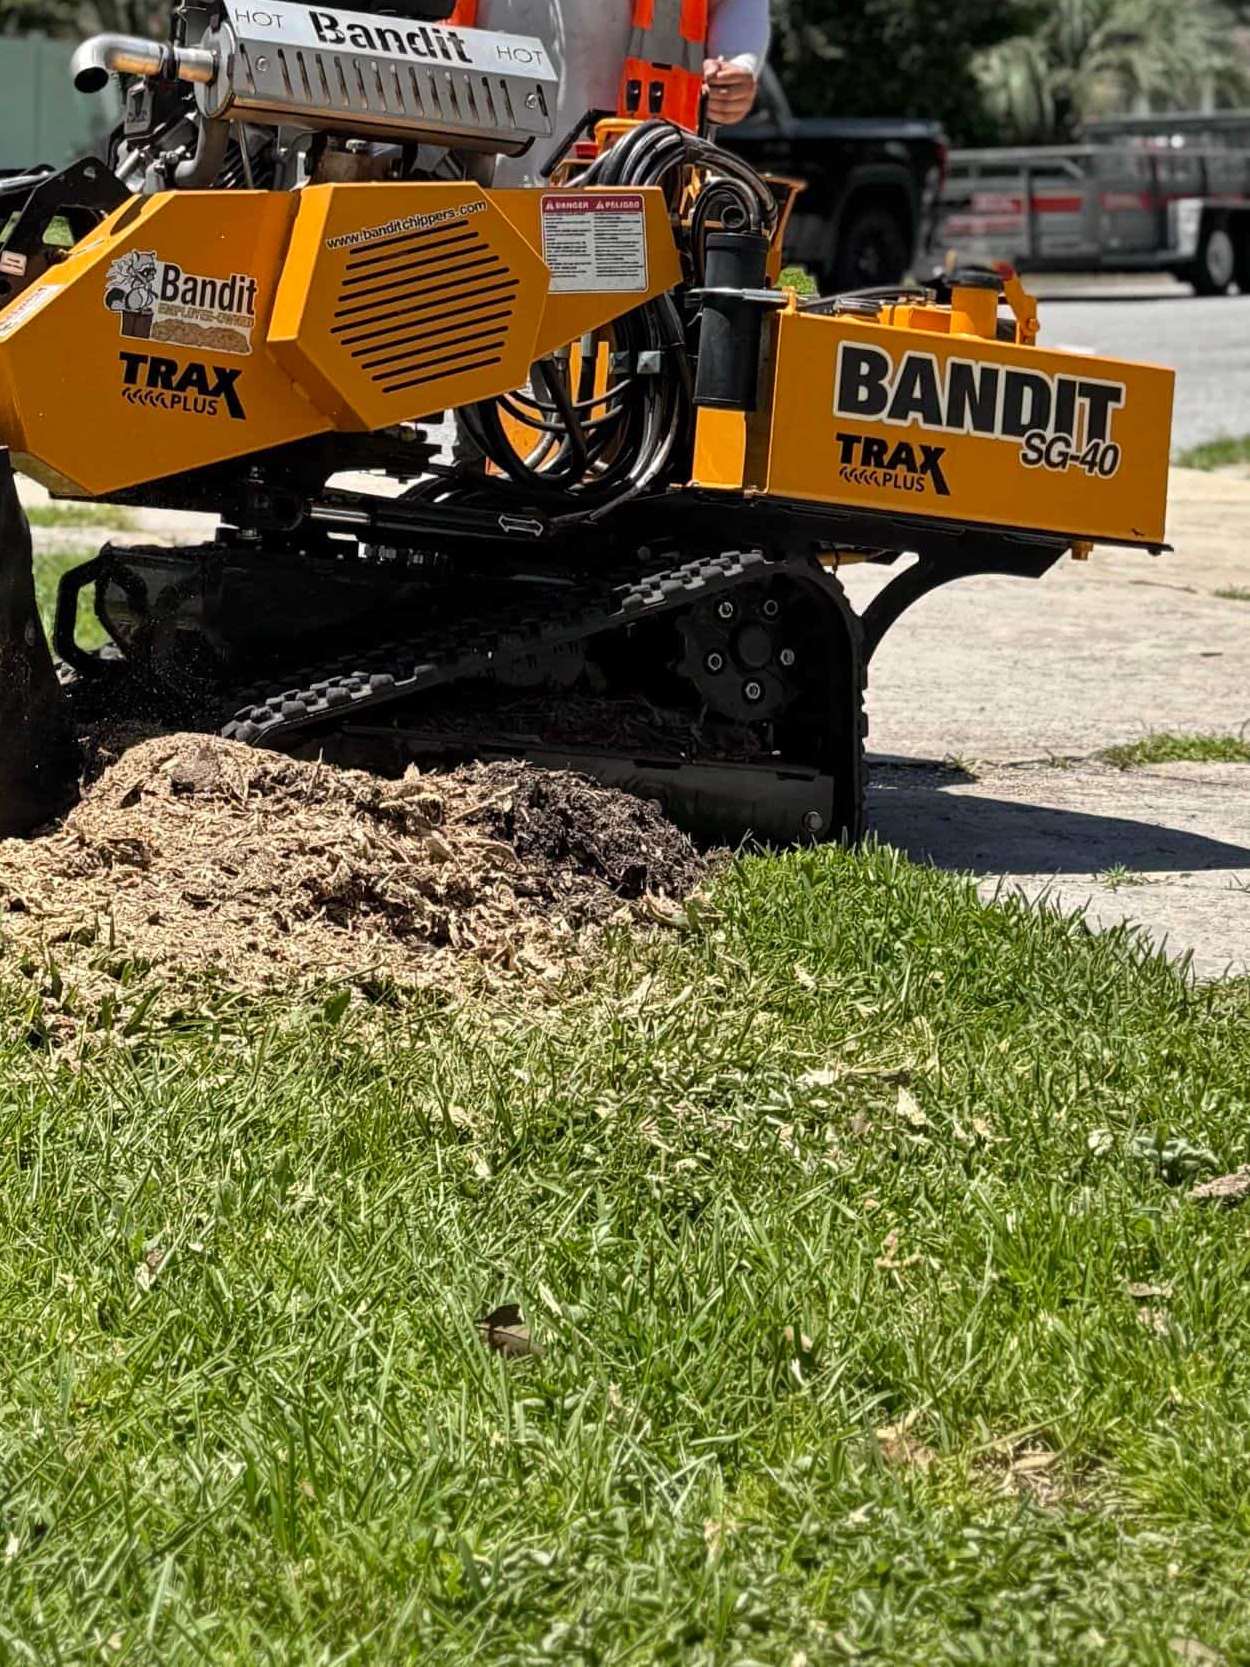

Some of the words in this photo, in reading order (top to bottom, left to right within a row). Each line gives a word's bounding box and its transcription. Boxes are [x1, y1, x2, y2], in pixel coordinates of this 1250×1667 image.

[235, 9, 285, 29] HOT
[308, 10, 473, 64] Bandit
[495, 45, 544, 66] HOT
[326, 200, 487, 249] www.banditchippers.com
[555, 201, 589, 209] DANGER
[160, 264, 257, 314] Bandit
[119, 351, 246, 420] TRAX
[170, 392, 218, 416] PLUS
[835, 342, 1125, 444] BANDIT
[836, 433, 950, 496] TRAX
[1021, 432, 1120, 478] SG-40
[882, 471, 925, 493] PLUS
